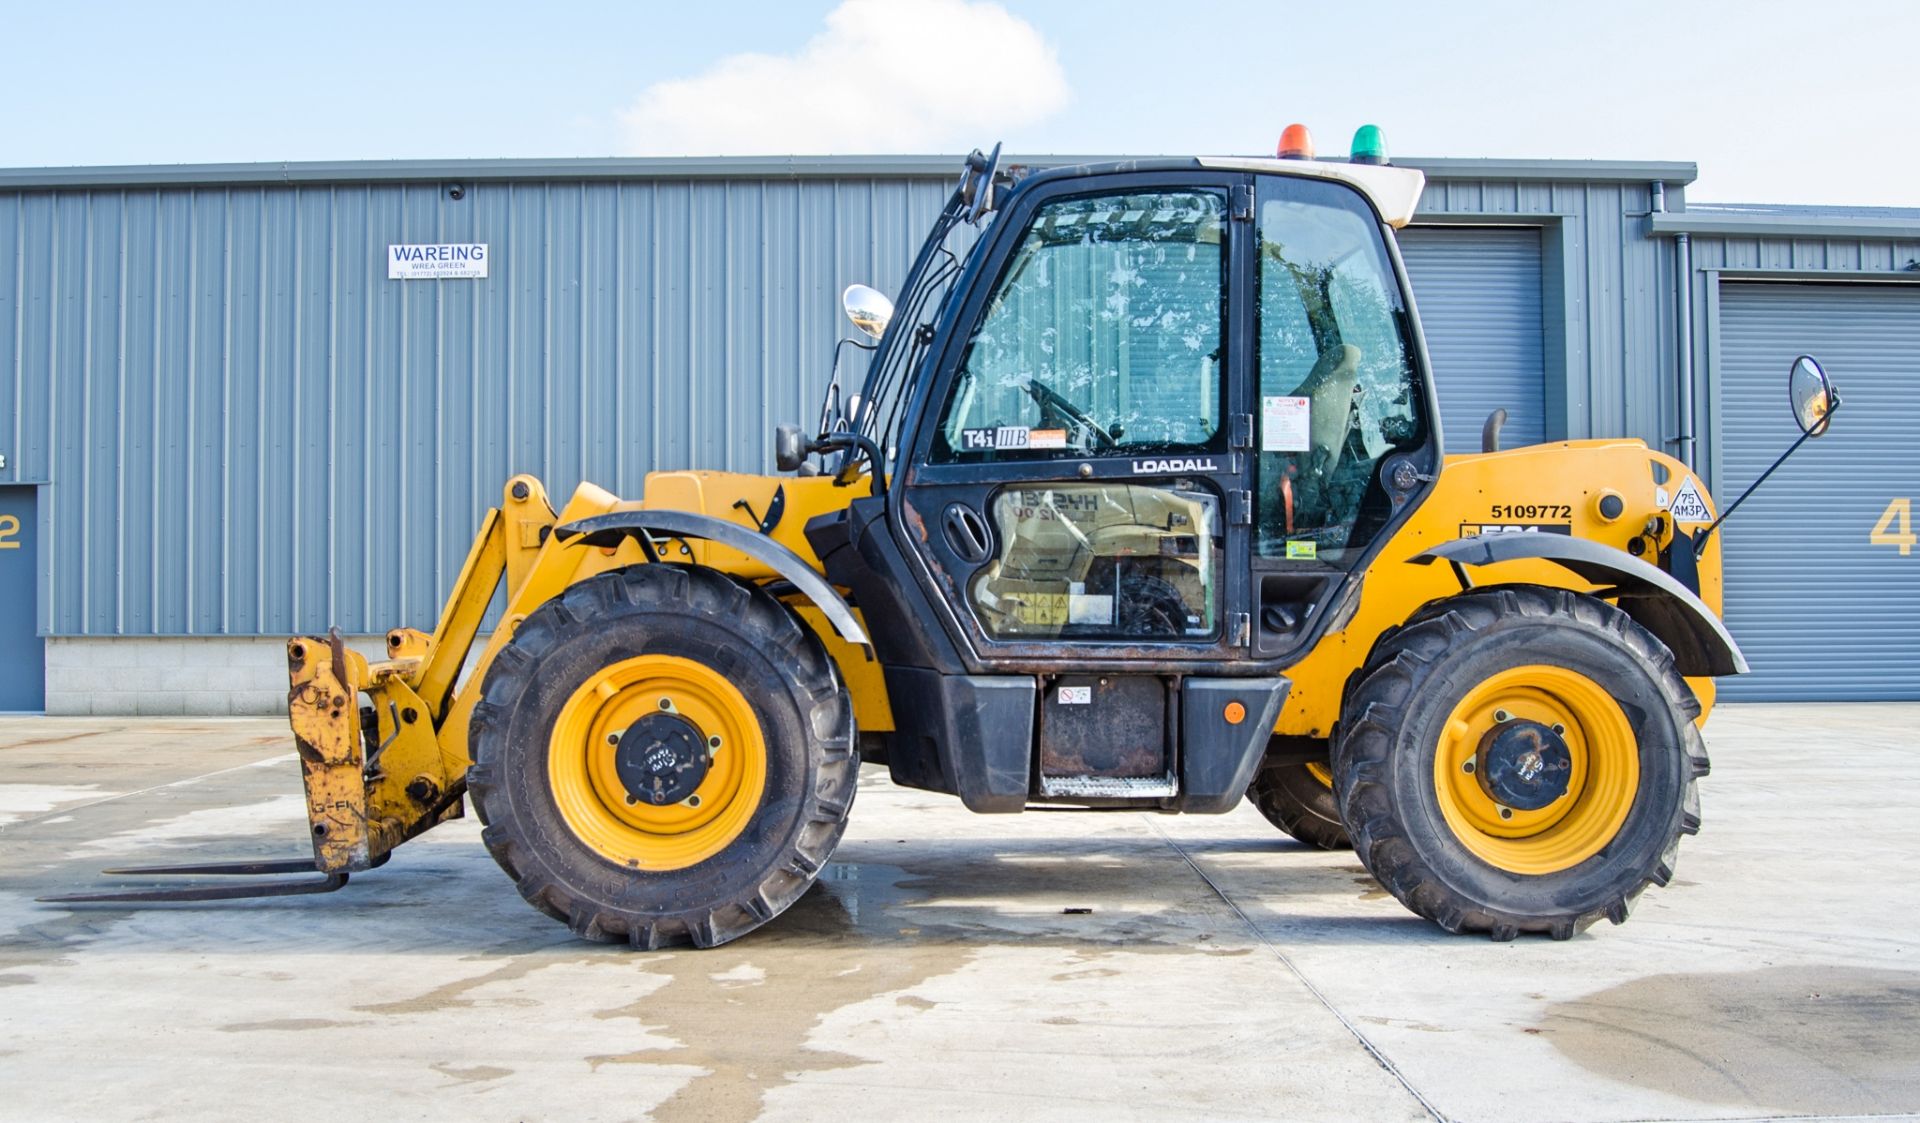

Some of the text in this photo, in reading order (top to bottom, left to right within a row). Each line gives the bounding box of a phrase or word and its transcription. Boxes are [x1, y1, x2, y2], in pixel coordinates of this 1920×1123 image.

[394, 246, 484, 261] WAREING
[412, 262, 435, 270] WREA
[963, 429, 994, 448] T4i
[1133, 459, 1217, 474] LOADALL
[1681, 493, 1695, 504] 75
[1491, 505, 1571, 518] 5109772
[1674, 505, 1702, 516] AM3P
[0, 514, 20, 549] 2
[1870, 498, 1917, 555] 4
